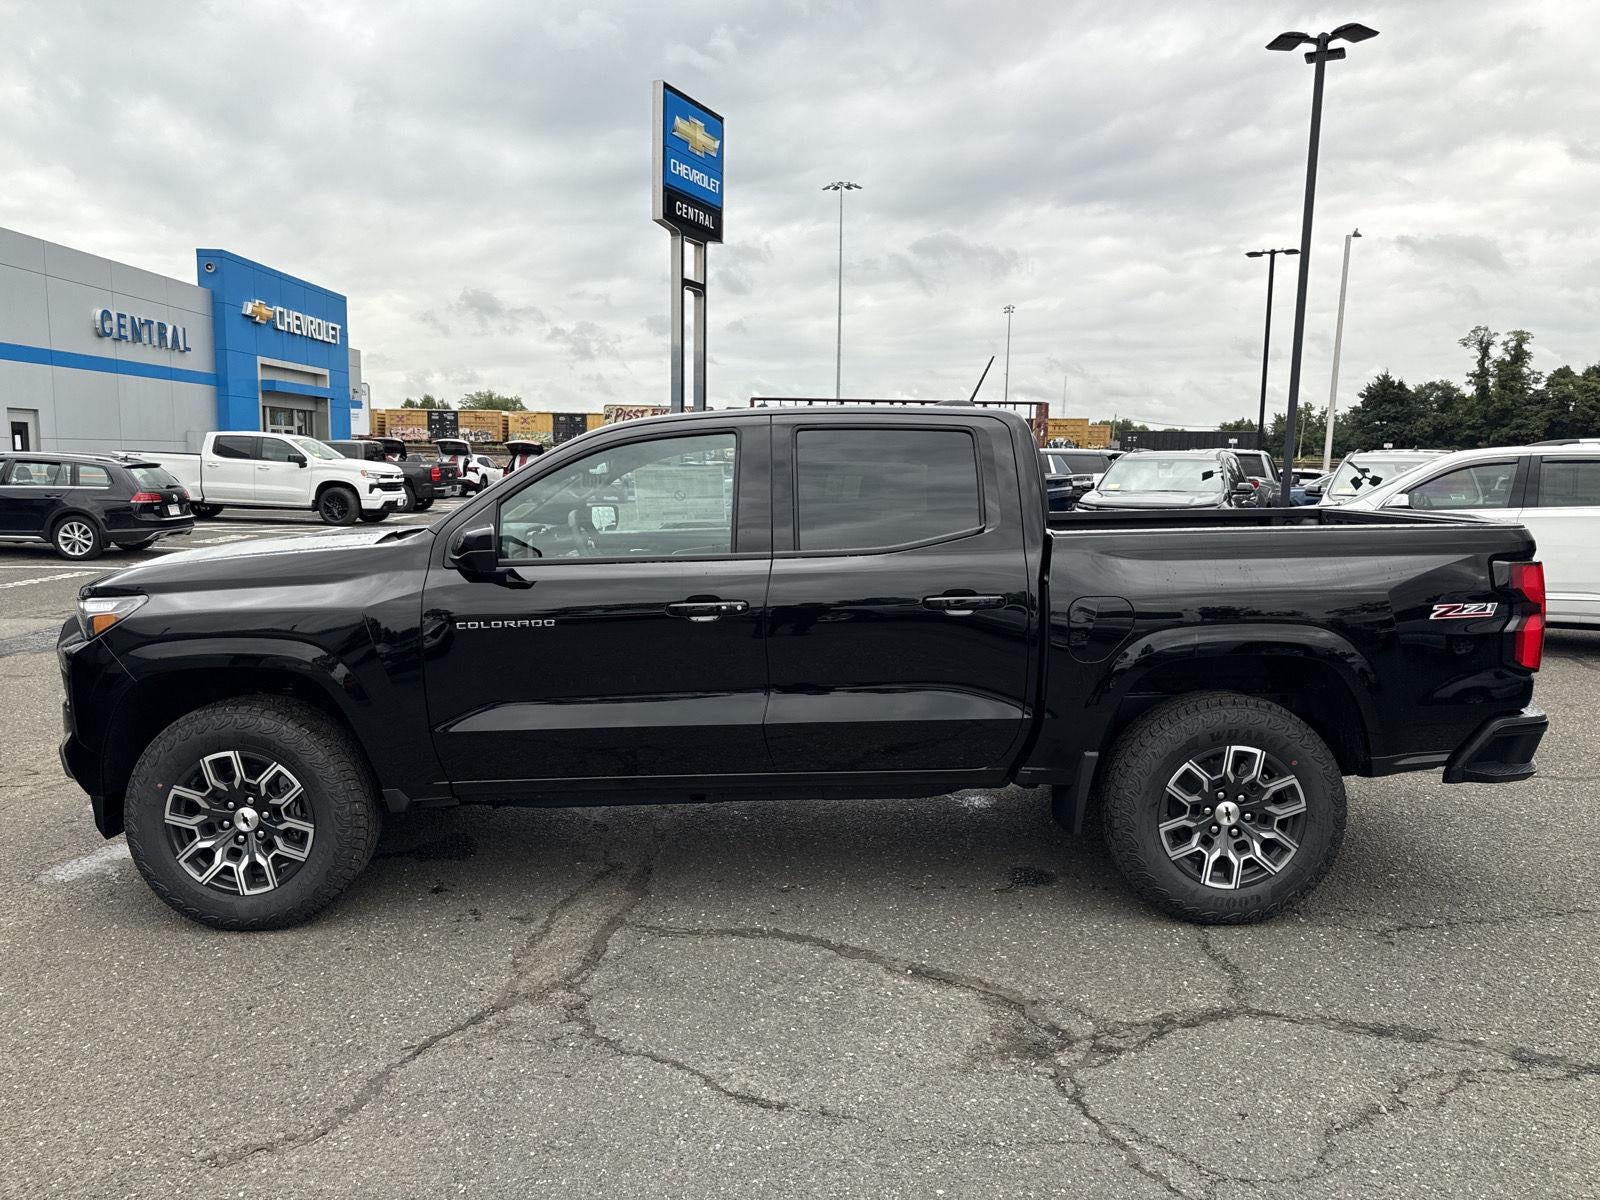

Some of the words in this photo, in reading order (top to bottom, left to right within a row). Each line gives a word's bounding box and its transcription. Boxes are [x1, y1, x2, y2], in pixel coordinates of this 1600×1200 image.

[670, 158, 720, 194] CHEVROLET
[675, 201, 714, 229] CENTRAL
[95, 308, 192, 352] CENTRAL
[274, 304, 341, 345] CHEVROLET
[456, 619, 555, 630] COLORADO
[1429, 602, 1498, 620] Z71
